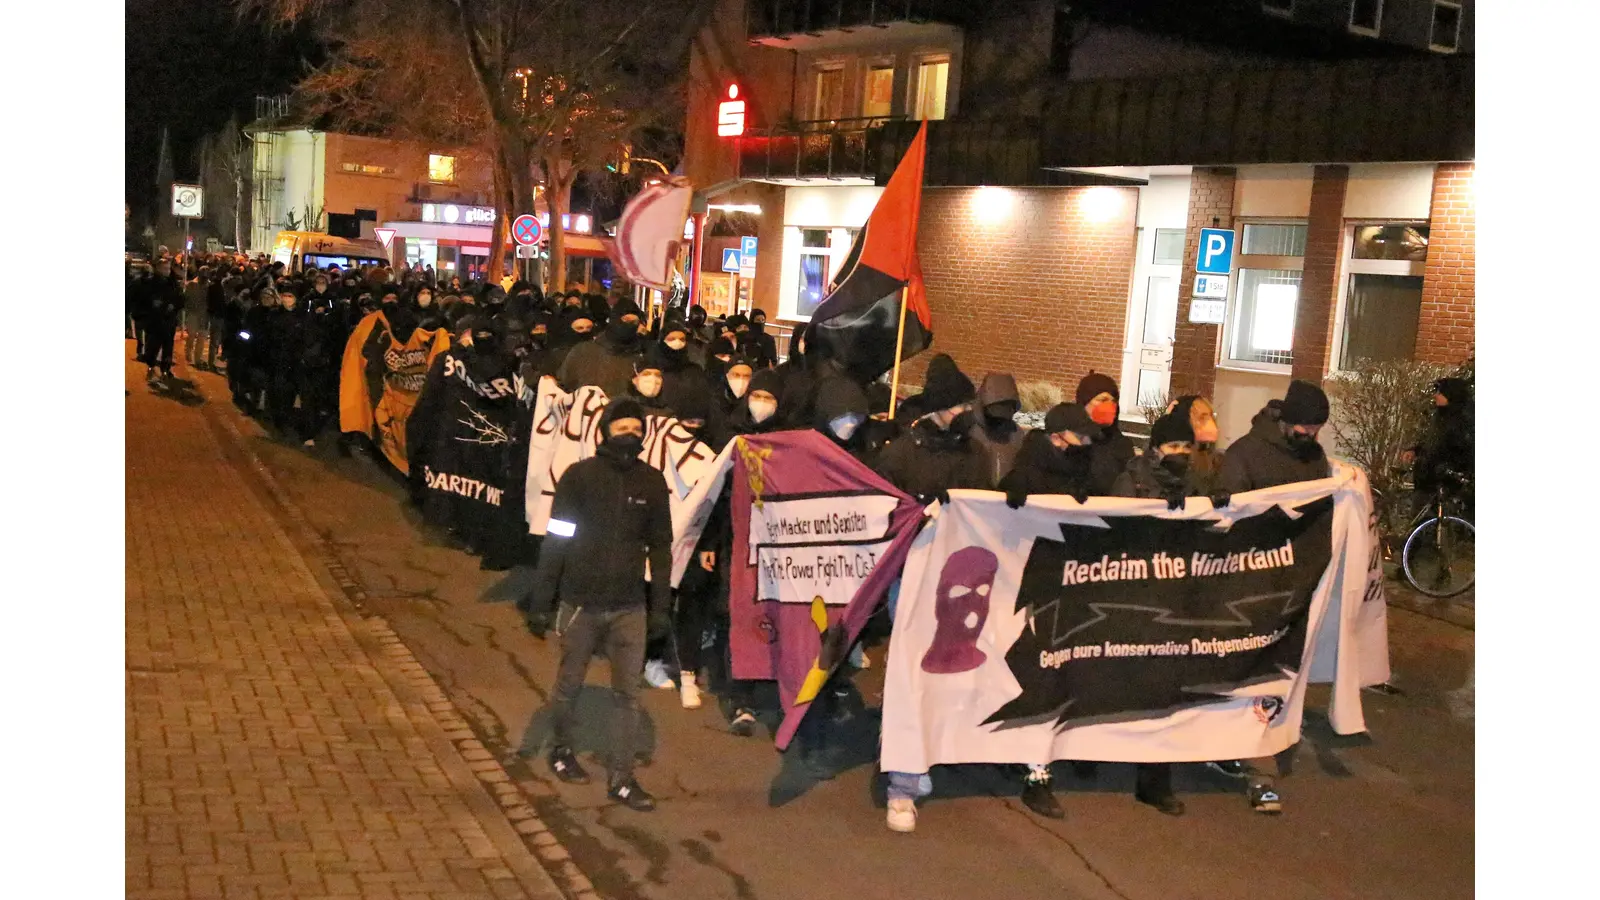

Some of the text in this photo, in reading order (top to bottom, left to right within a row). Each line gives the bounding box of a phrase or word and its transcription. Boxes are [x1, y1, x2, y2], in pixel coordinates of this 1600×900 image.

[183, 195, 194, 203] 30
[745, 240, 756, 254] P
[1204, 234, 1226, 268] P
[780, 517, 811, 537] Macker
[814, 513, 832, 535] und
[834, 511, 868, 534] Sexisten
[1062, 538, 1294, 586] Reclaim the Hinterland
[1104, 640, 1190, 657] konservative
